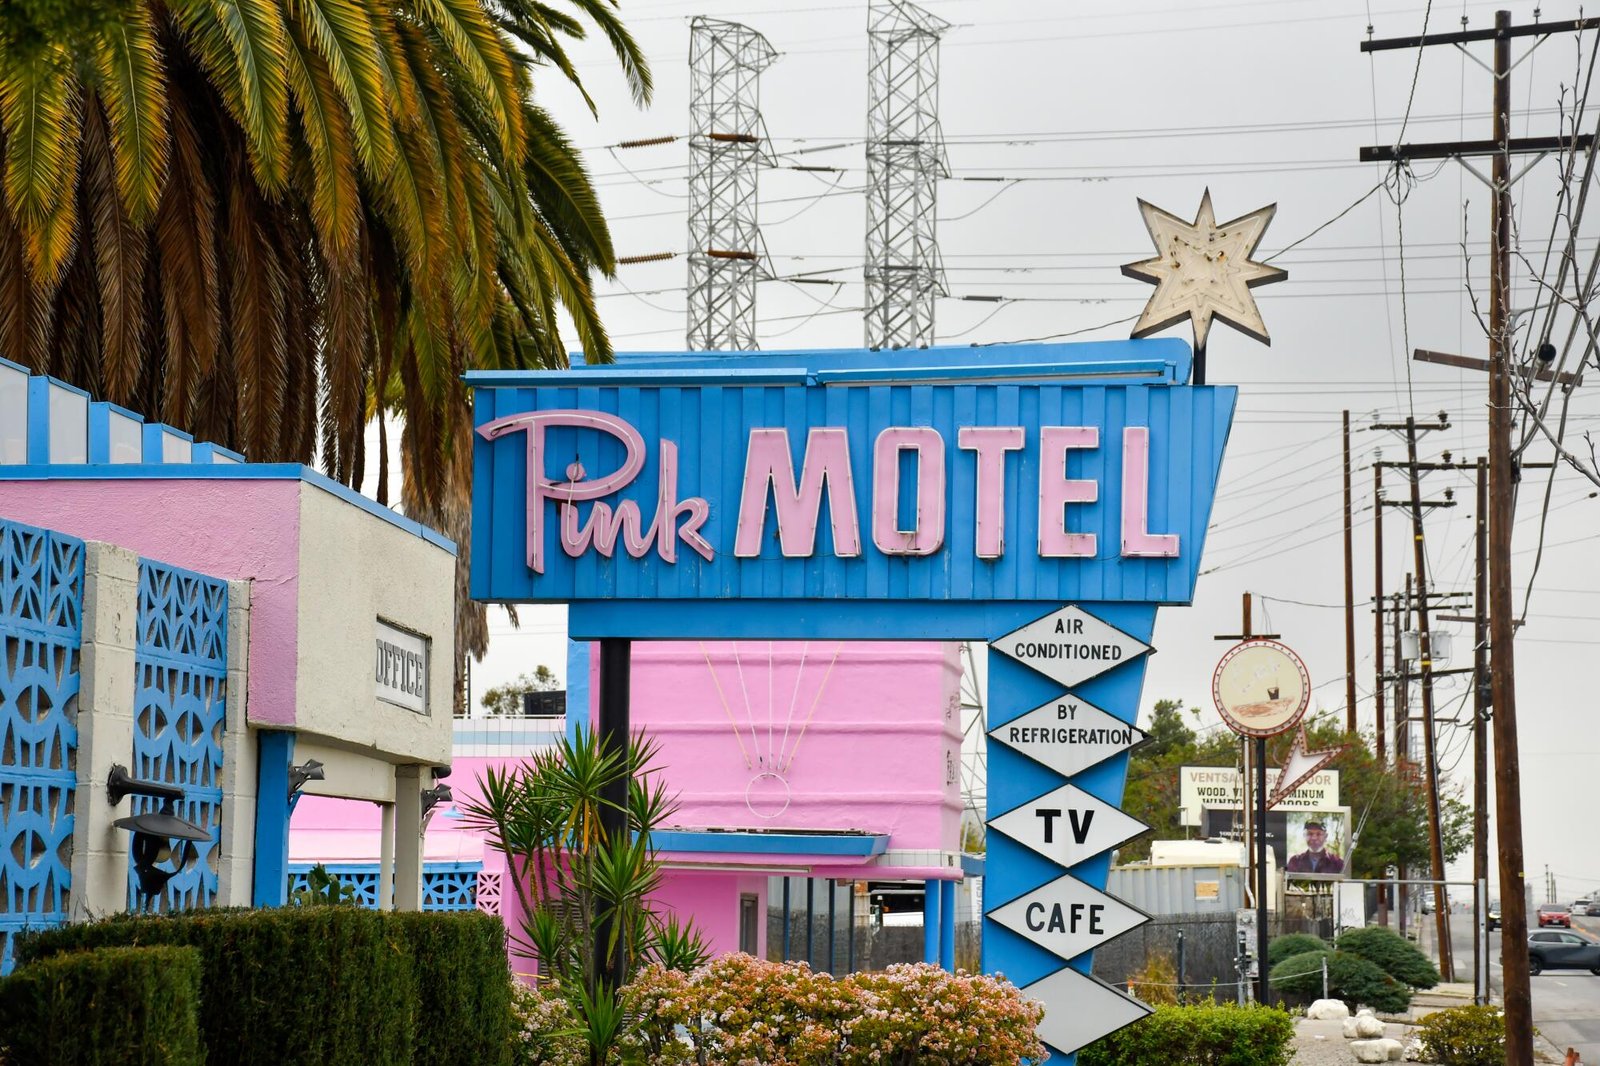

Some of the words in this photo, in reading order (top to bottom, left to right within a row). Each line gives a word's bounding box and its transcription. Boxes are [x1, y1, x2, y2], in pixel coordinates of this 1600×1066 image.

[476, 409, 714, 575] Pink
[735, 427, 1180, 558] MOTEL
[1054, 618, 1084, 635] AIR
[1014, 642, 1123, 661] CONDITIONED
[375, 638, 423, 698] OFFICE
[1057, 704, 1078, 721] BY
[1009, 727, 1132, 745] REFRIGERATION
[1035, 808, 1095, 845] TV
[1025, 902, 1105, 936] CAFE
